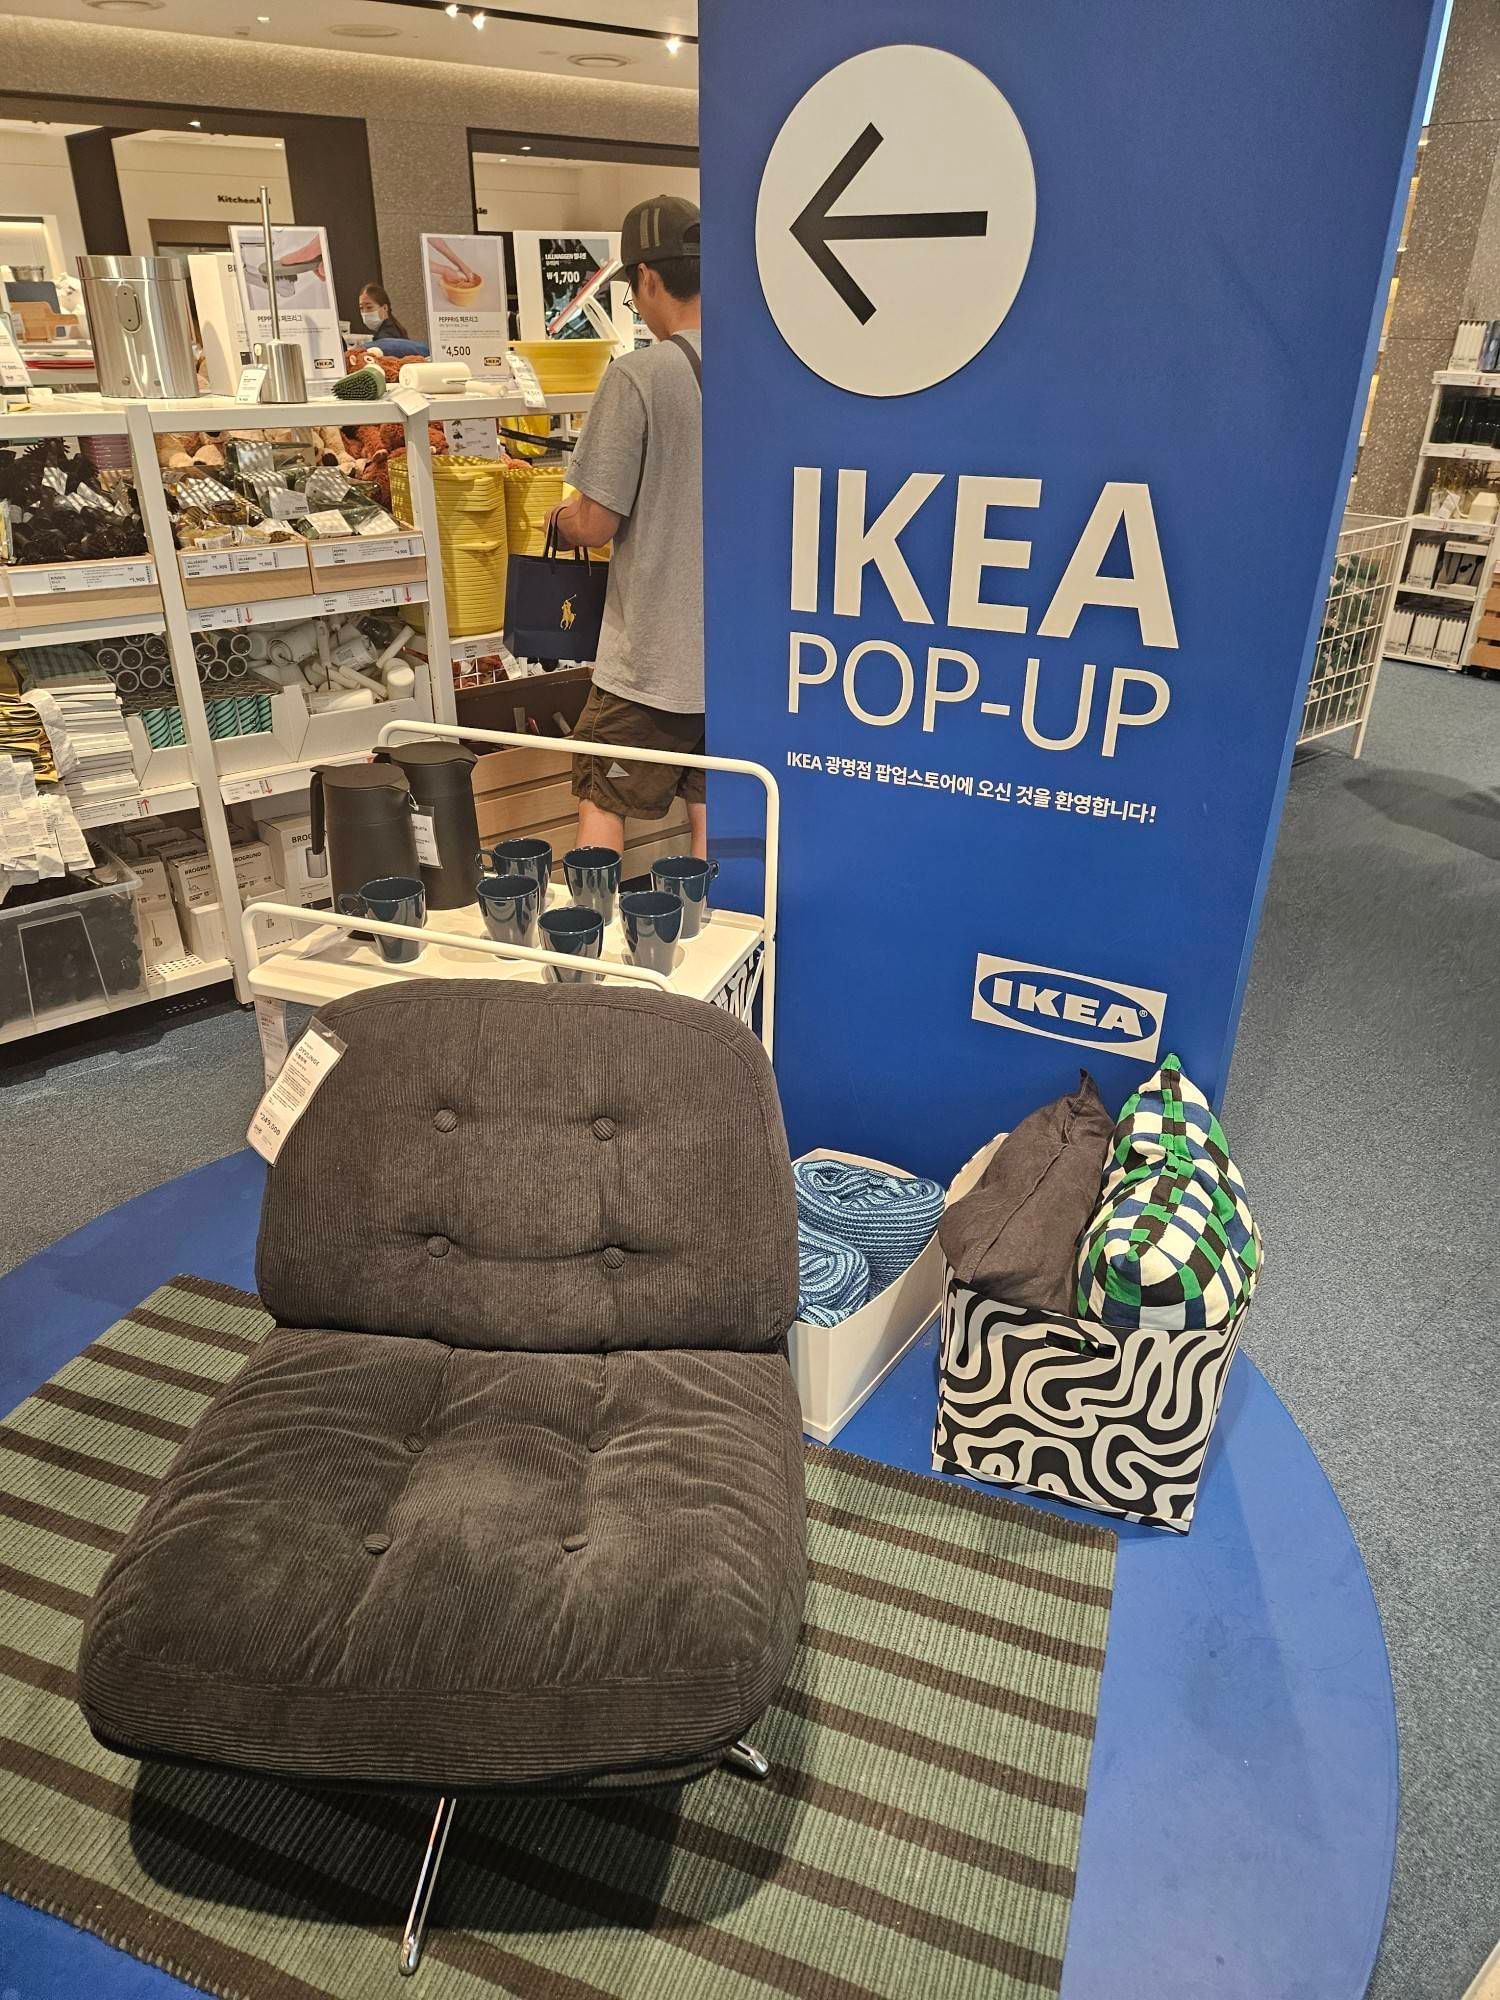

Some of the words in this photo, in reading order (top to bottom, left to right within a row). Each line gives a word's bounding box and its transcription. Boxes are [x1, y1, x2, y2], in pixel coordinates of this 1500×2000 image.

[791, 467, 1179, 649] IKEA
[789, 632, 1170, 757] POP-UP
[787, 751, 823, 772] IKEA
[825, 756, 872, 780] 광명점
[875, 763, 974, 797] 팝업스토어에
[977, 780, 1012, 802] 오신
[1016, 786, 1052, 808] 것을
[1055, 791, 1157, 824] 환영합니다!
